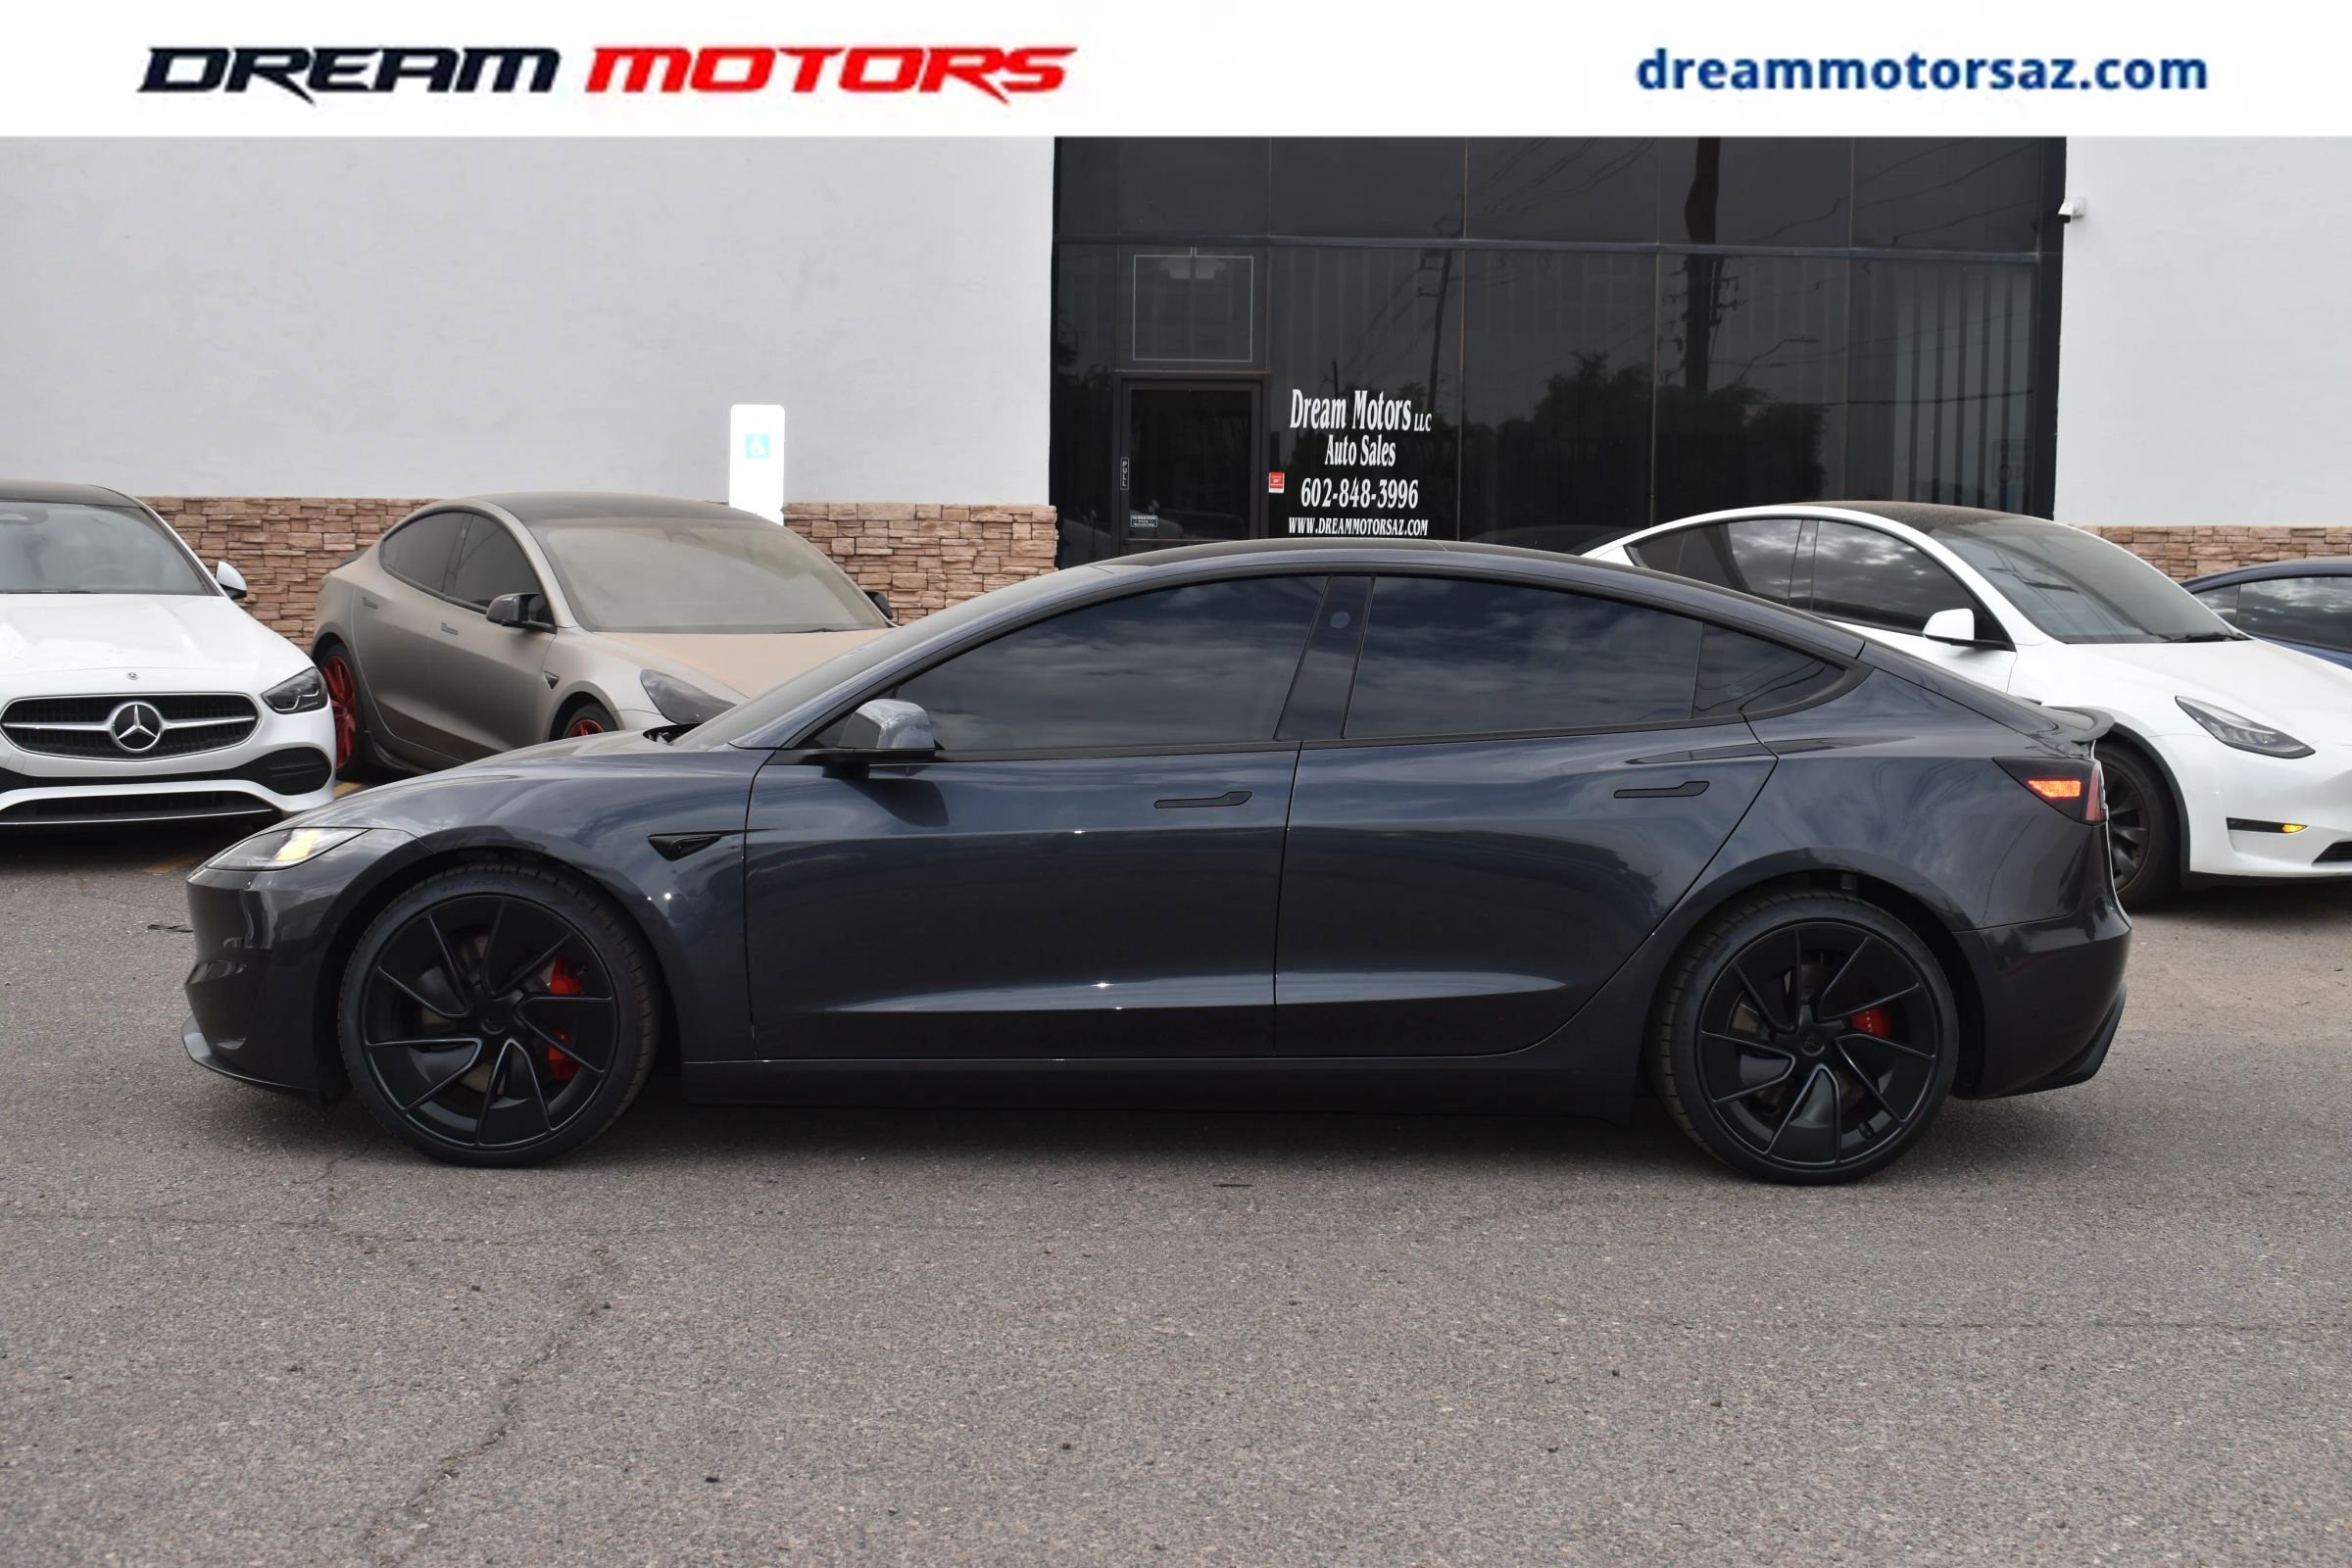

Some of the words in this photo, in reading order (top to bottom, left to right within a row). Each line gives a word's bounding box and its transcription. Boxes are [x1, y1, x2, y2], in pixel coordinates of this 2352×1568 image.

[1290, 389, 1347, 429] Dream
[1351, 390, 1412, 431] Motors
[1414, 413, 1432, 432] LLC
[1325, 434, 1357, 466] Auto
[1360, 434, 1396, 467] Sales
[1300, 477, 1419, 510] 602-848-3996
[1289, 517, 1428, 536] WWW.DREAMMOTORSAZ.COM
